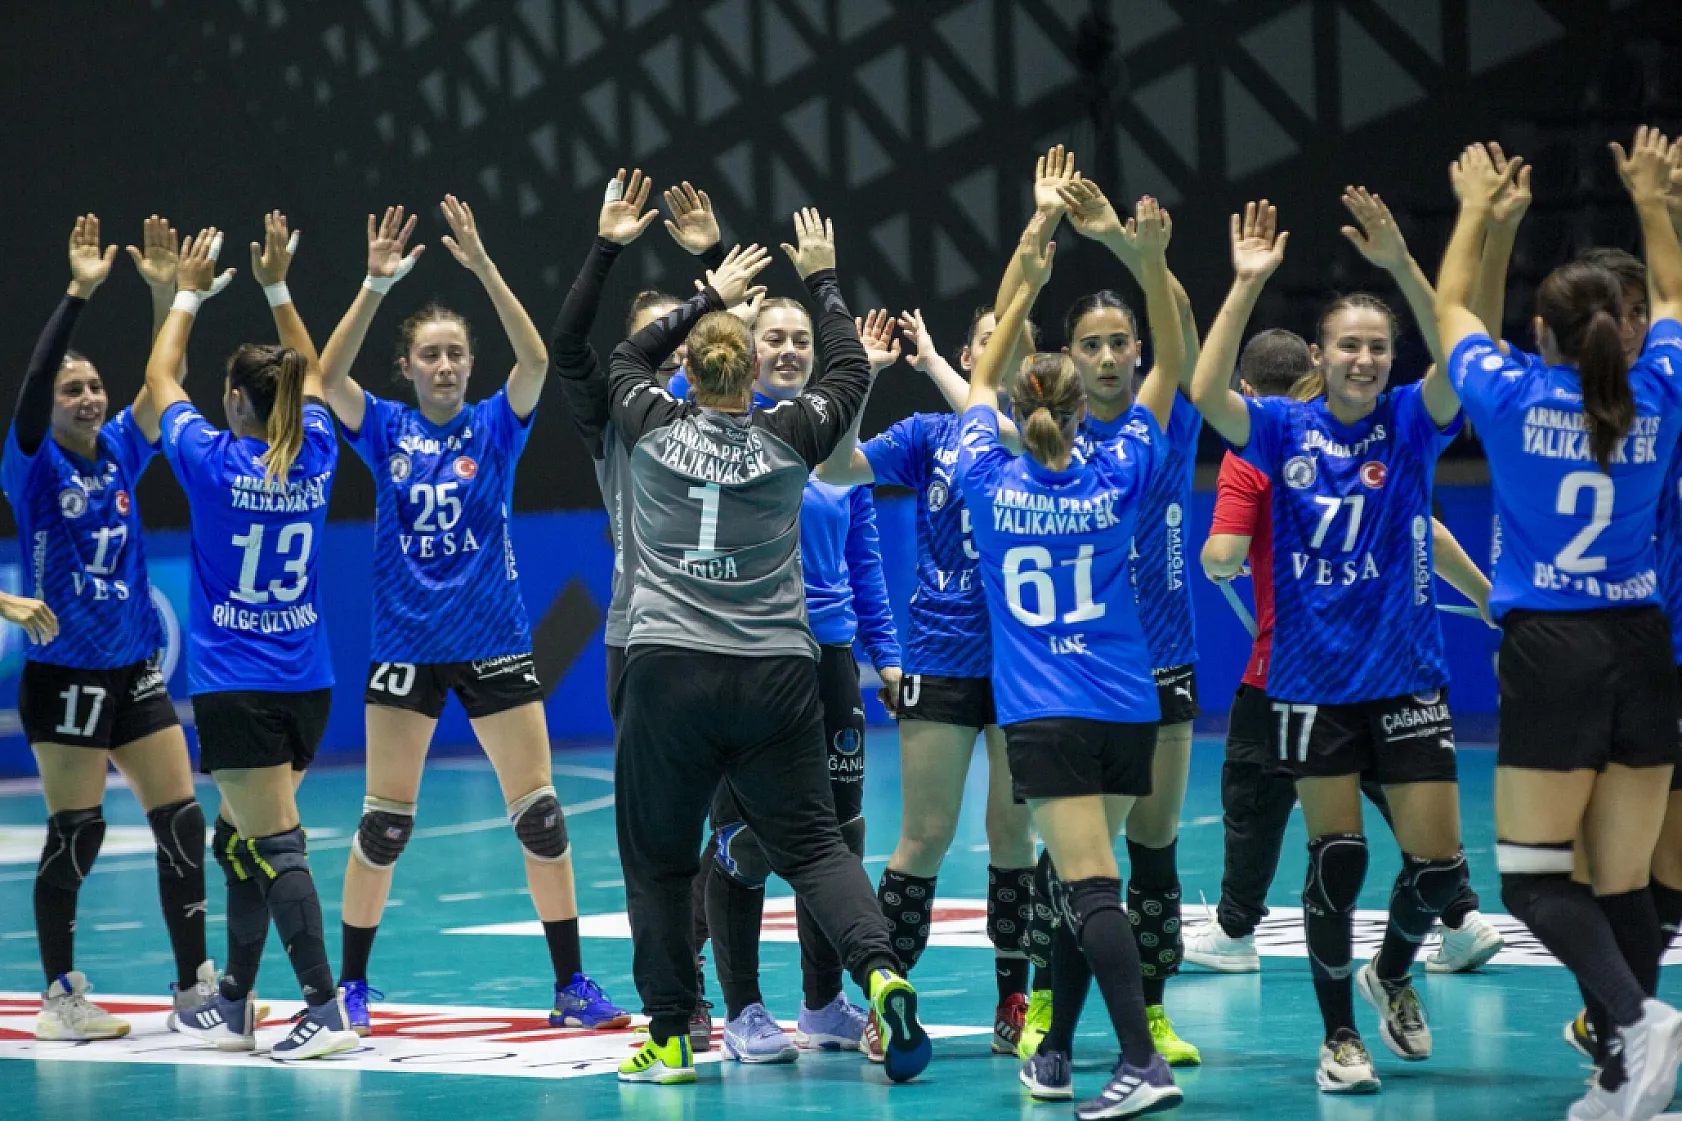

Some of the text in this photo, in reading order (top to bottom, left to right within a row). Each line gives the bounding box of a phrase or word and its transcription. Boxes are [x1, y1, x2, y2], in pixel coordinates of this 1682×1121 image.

[1526, 406, 1592, 429] ARMAD
[661, 437, 773, 485] YALIKAVAK SK
[720, 433, 763, 462] PRIS
[1523, 425, 1657, 464] YALIKAK SK
[409, 481, 462, 531] 25
[683, 481, 720, 560] 1
[993, 488, 1056, 513] ARMADA
[993, 505, 1120, 535] YALIKAVAK SK
[1310, 494, 1366, 551] 77
[1556, 471, 1615, 573] 2
[85, 523, 128, 575] 17
[229, 522, 313, 603] 13
[400, 528, 480, 558] VESA
[1171, 527, 1184, 590] MUĞLA
[1002, 544, 1105, 626] 61
[1291, 551, 1380, 586] VESA
[1417, 541, 1430, 605] MUĞLA
[212, 601, 259, 631] BİLGE
[55, 684, 107, 738] 17
